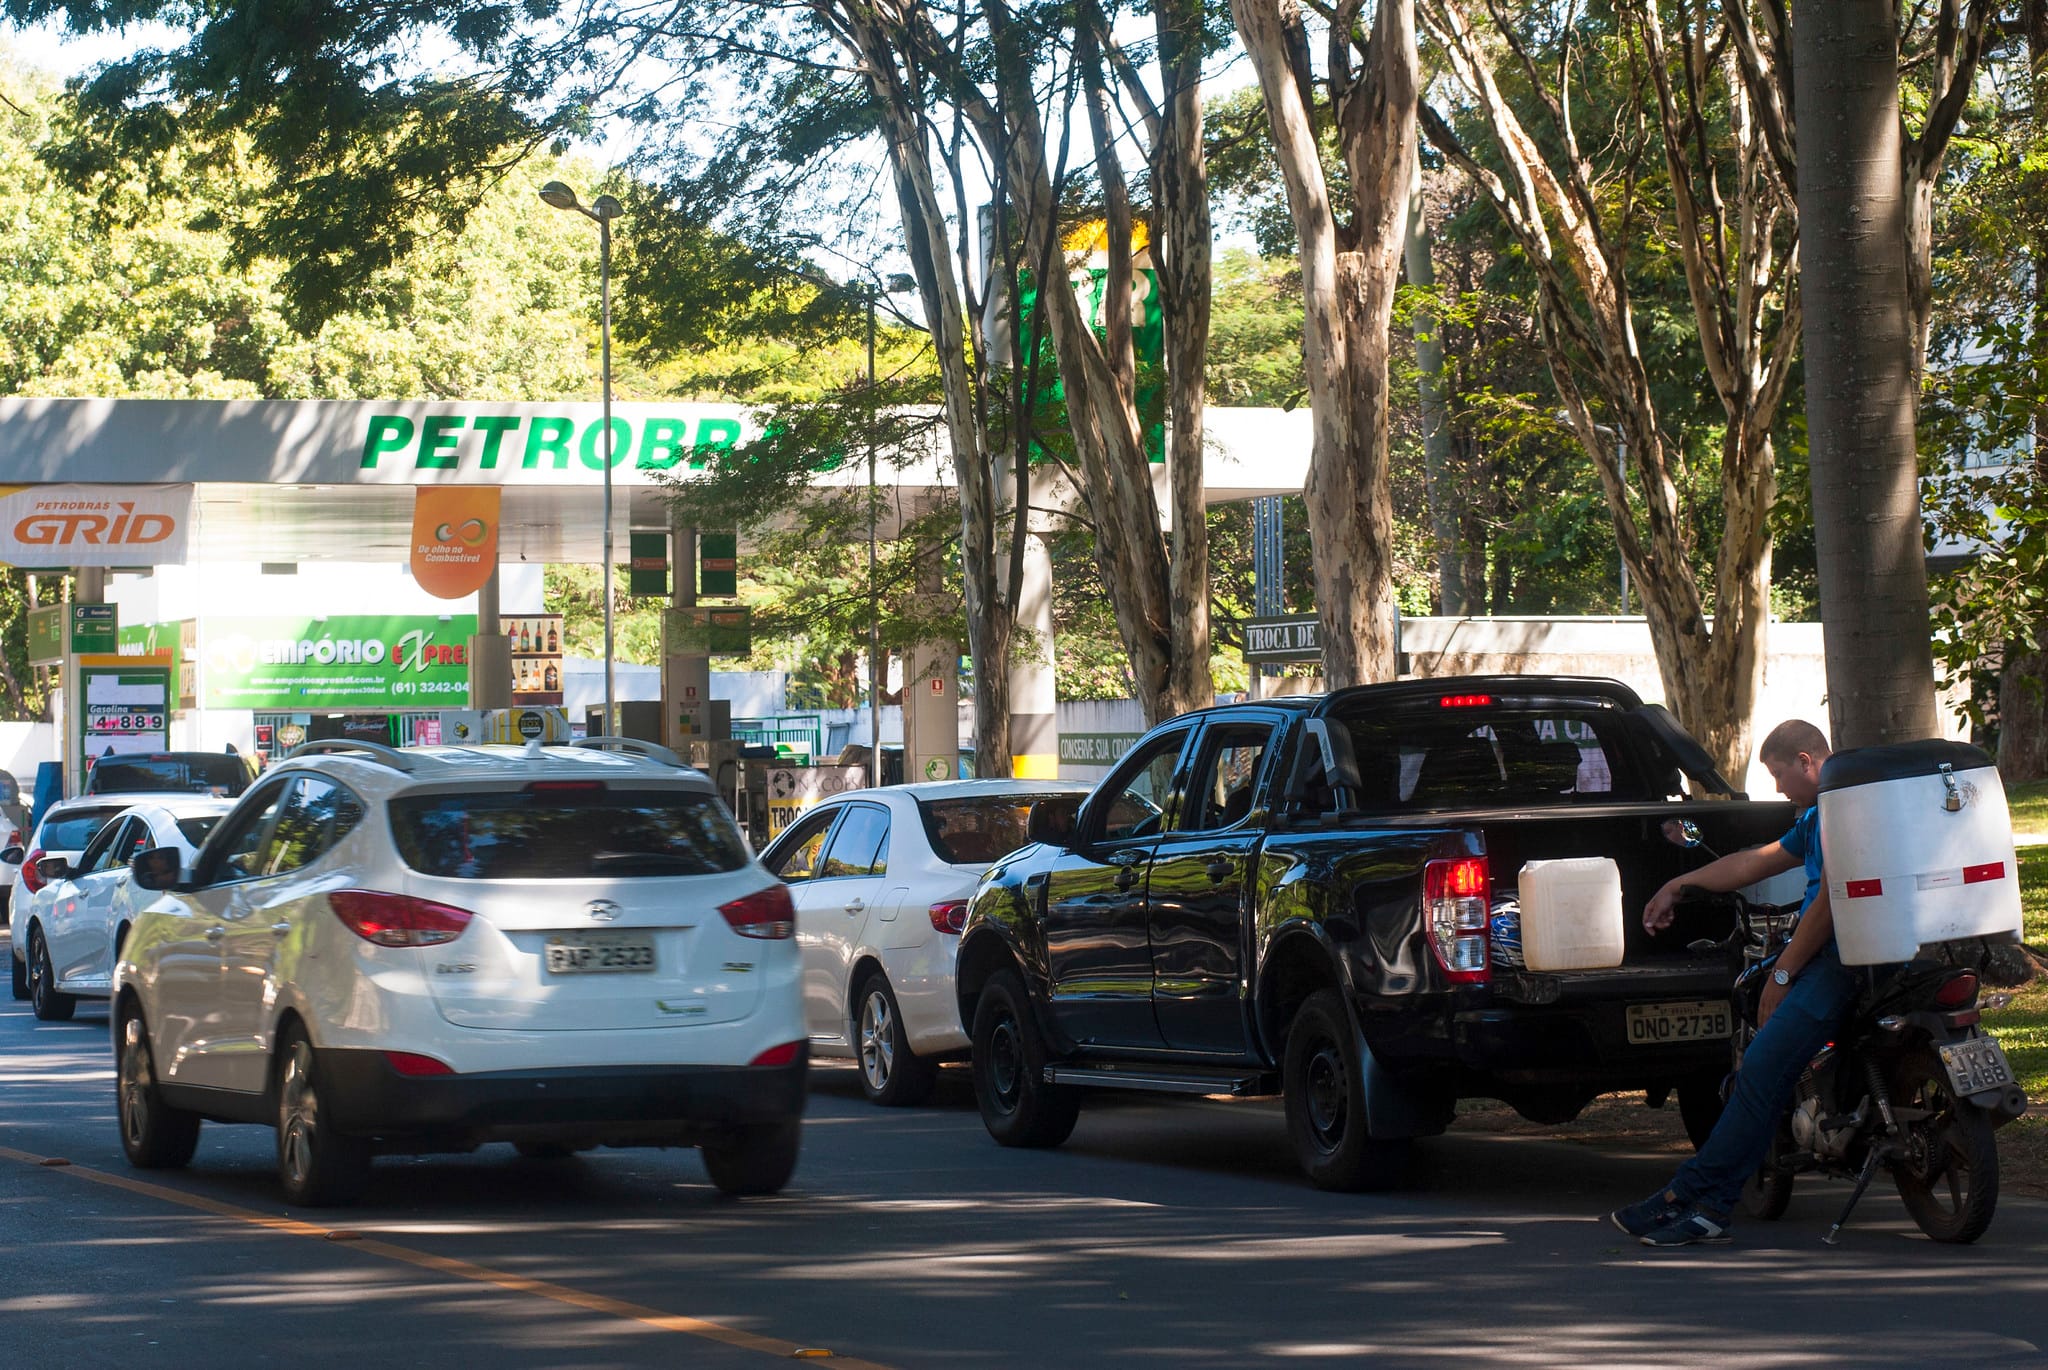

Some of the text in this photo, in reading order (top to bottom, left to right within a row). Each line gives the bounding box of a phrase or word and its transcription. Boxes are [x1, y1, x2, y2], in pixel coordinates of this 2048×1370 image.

[359, 415, 844, 472] PETROBR
[36, 502, 111, 511] PETROBRAS
[13, 502, 176, 545] GRID
[76, 607, 85, 618] G
[76, 623, 85, 634] E
[1246, 625, 1315, 651] TROCA DE
[260, 632, 386, 665] EMPÓRIO
[391, 682, 417, 696] (61)
[90, 705, 129, 713] Gasolina
[97, 716, 163, 729] 4,889
[1060, 738, 1094, 760] CONSERVE
[1095, 739, 1110, 761] SUA
